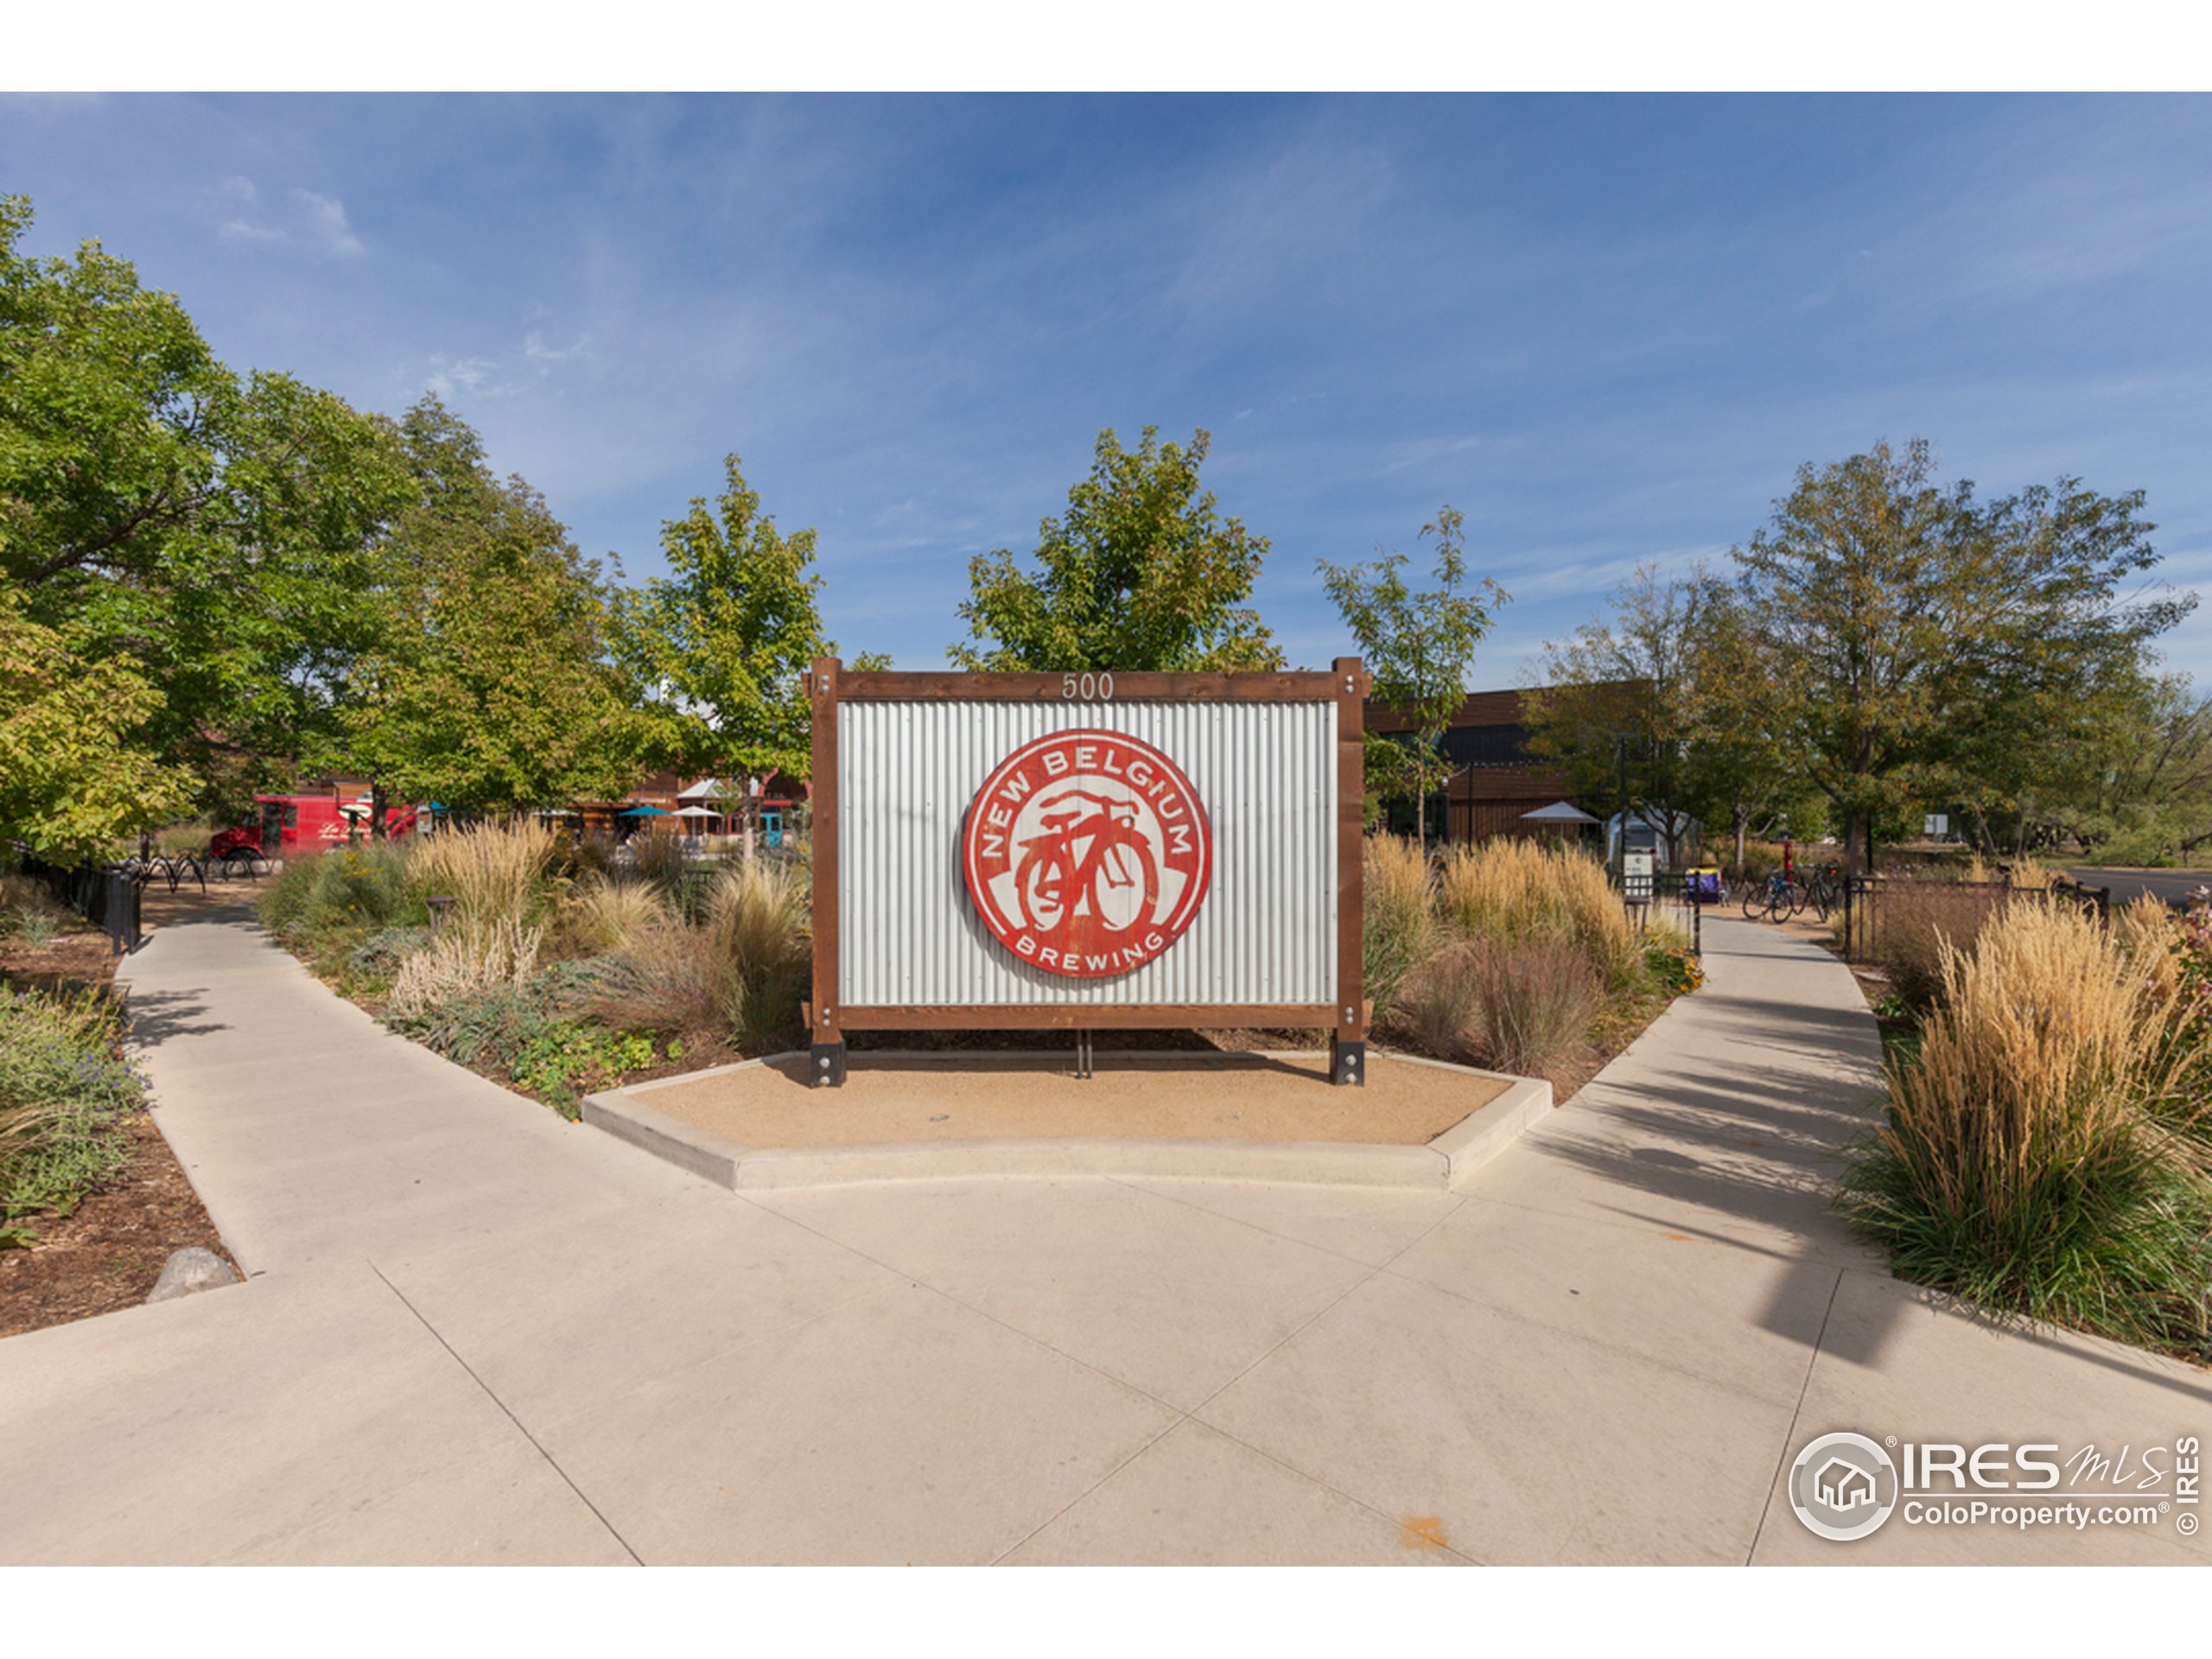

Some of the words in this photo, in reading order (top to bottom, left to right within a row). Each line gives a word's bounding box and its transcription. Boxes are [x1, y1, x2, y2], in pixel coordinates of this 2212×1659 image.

[1062, 672, 1114, 700] 500
[982, 770, 1033, 858] NEW
[1041, 746, 1193, 855] BELGIUM
[1015, 931, 1165, 972] BREWING
